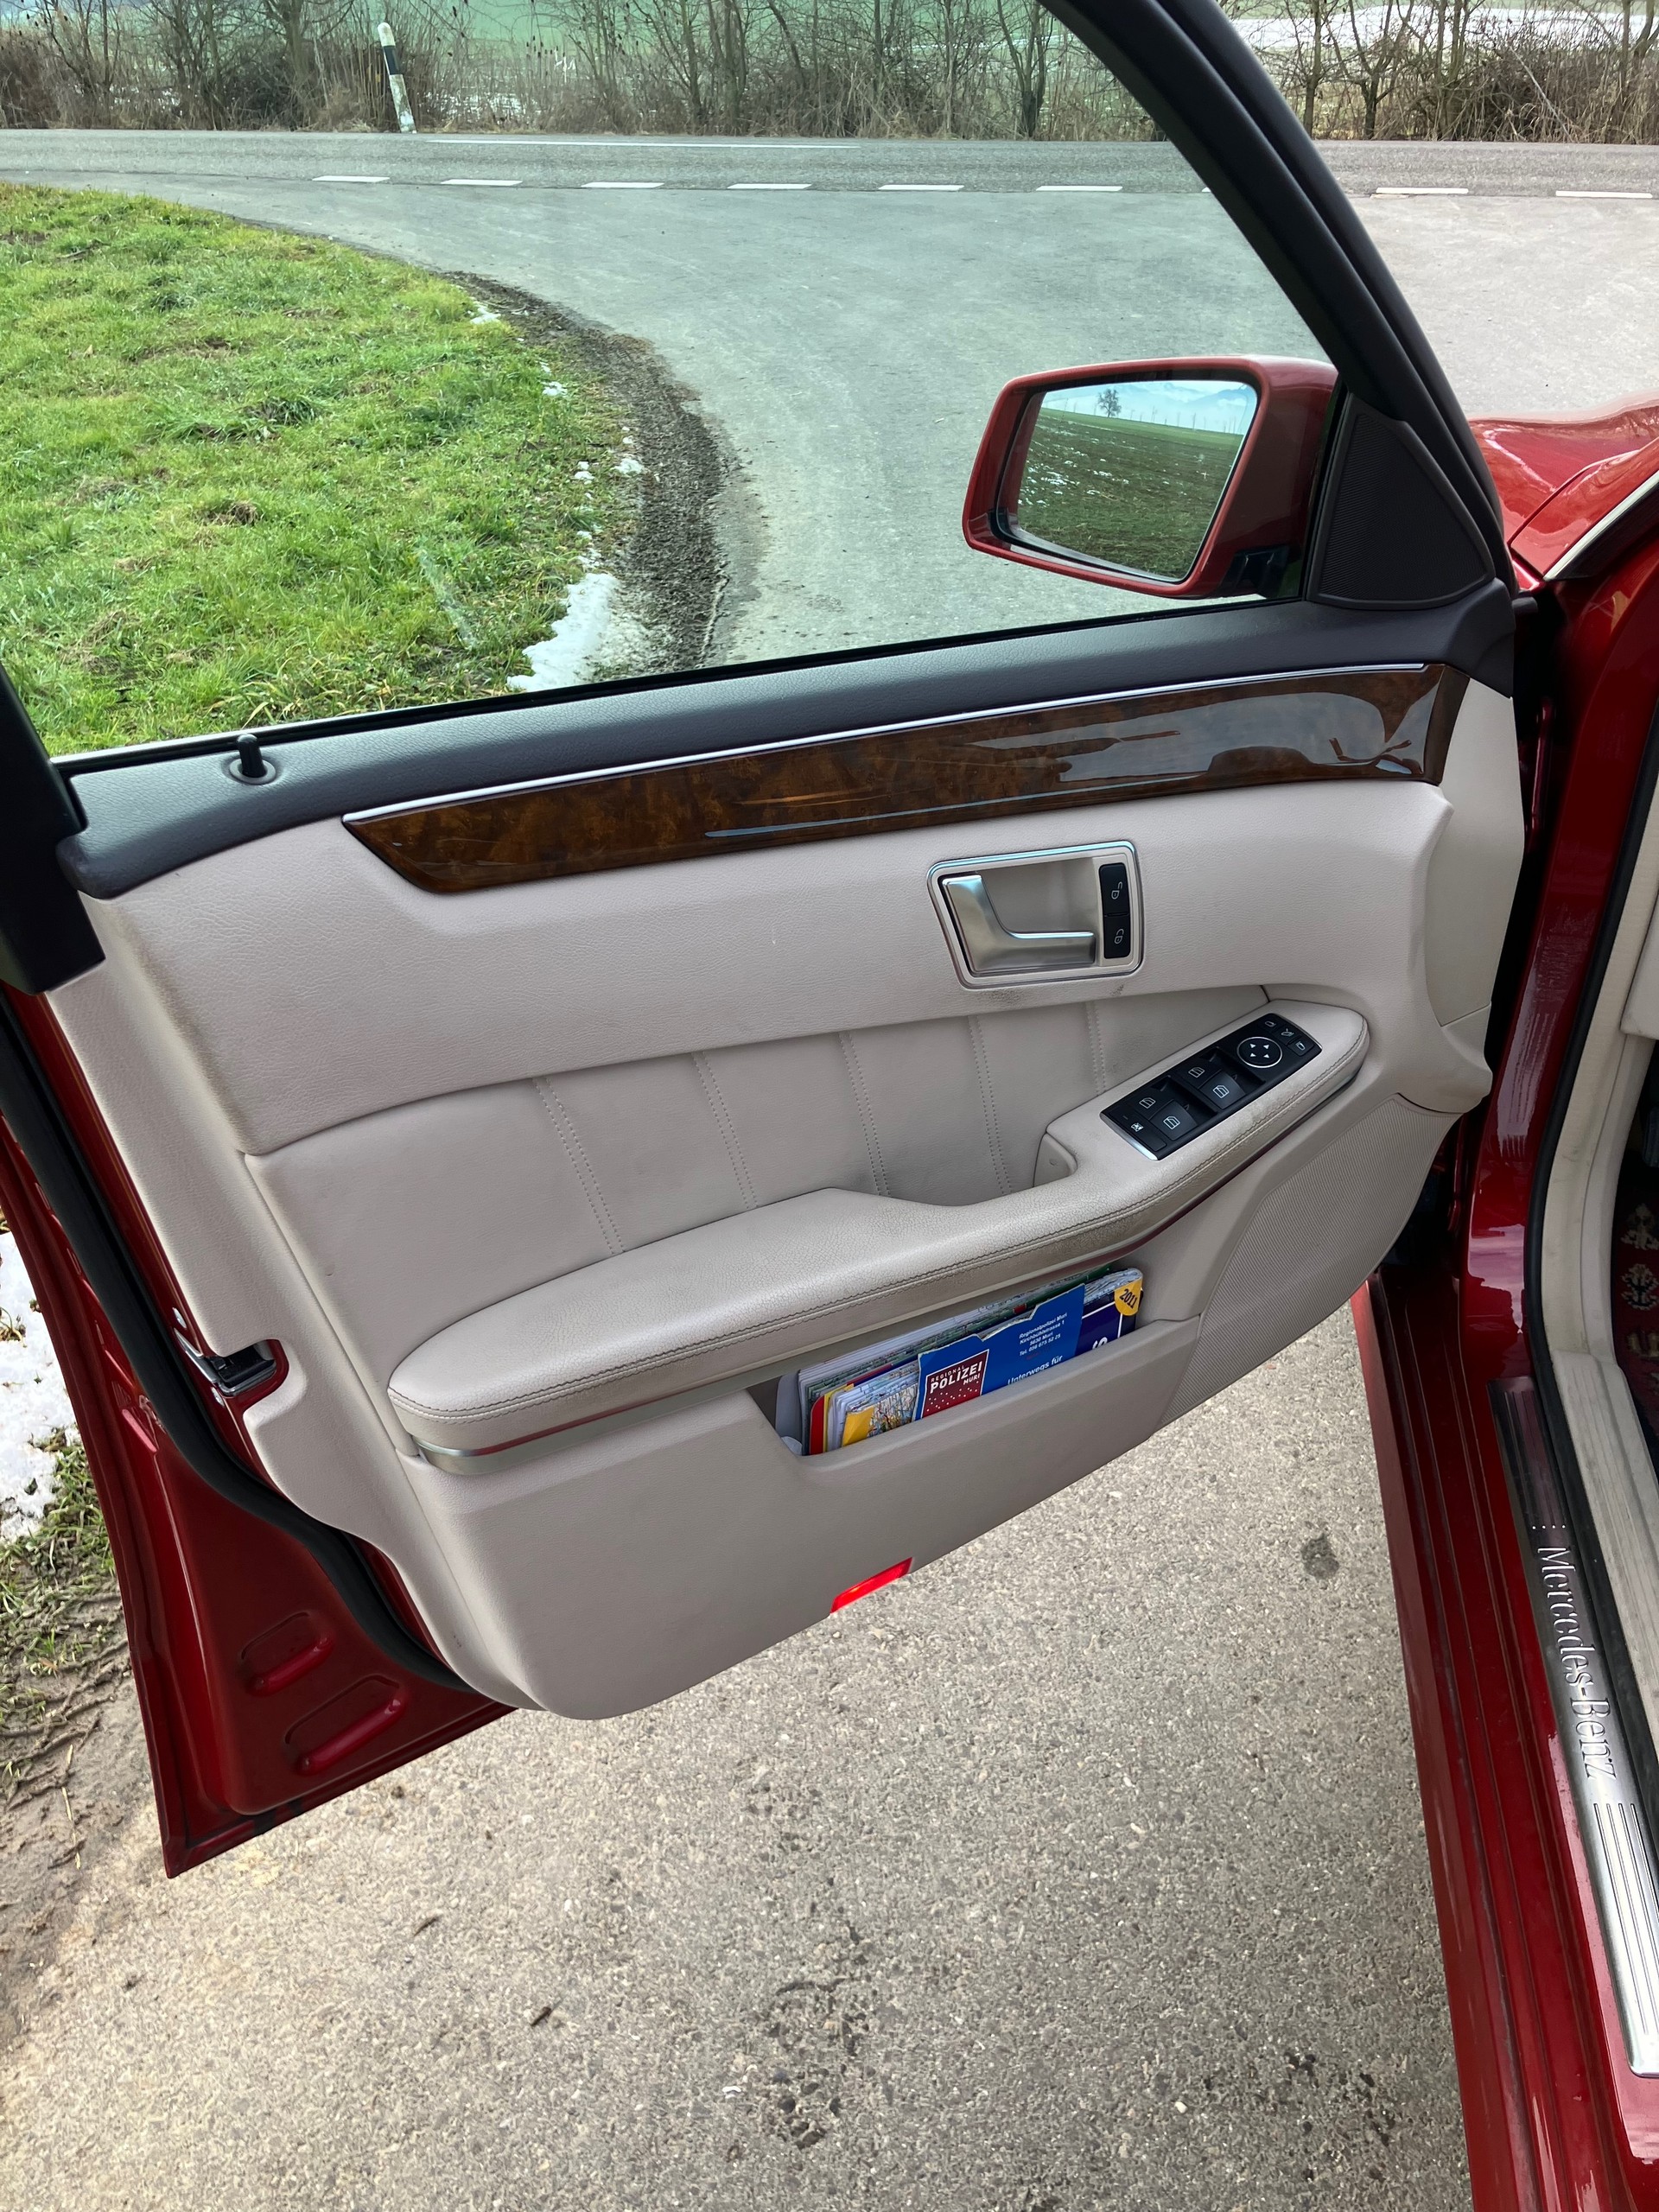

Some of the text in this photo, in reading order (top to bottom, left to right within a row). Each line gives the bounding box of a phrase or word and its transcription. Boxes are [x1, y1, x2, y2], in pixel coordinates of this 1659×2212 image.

[1120, 1288, 1138, 1309] 2011
[1019, 1313, 1068, 1339] Regionalpolizei Muri
[1042, 1332, 1053, 1340] Muri
[1051, 1355, 1063, 1365] für
[930, 1361, 983, 1394] POLIZEI
[931, 1365, 965, 1382] REGIONAL
[963, 1372, 980, 1386] MURI
[1537, 1547, 1617, 1779] Mercedes-Benz
